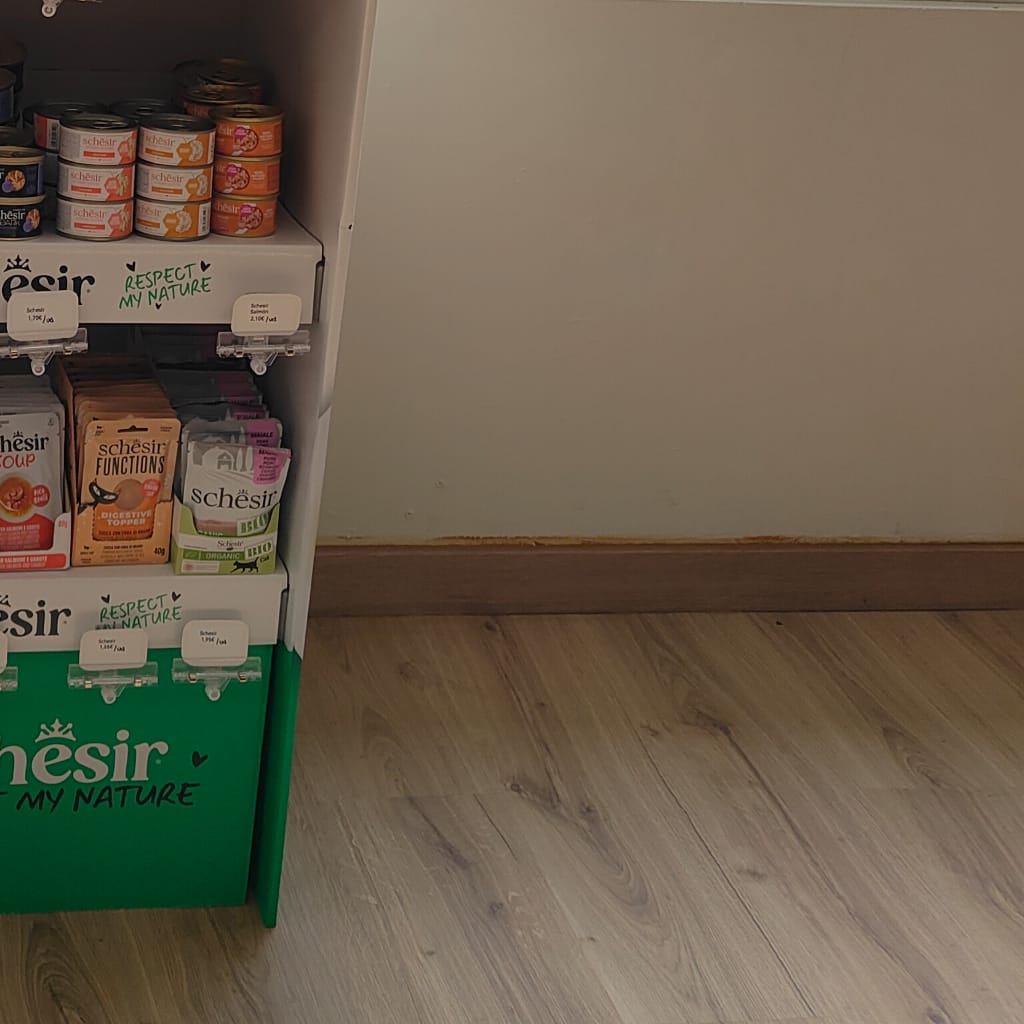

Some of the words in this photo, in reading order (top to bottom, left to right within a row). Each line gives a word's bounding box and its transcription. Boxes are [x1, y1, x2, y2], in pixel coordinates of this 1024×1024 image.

[125, 264, 196, 292] RESPECT
[118, 293, 142, 310] MY
[148, 276, 212, 305] NATURE
[96, 455, 165, 476] FUNCTIONS
[101, 510, 153, 520] DIGESTIVE
[107, 518, 146, 526] TOPPER
[99, 594, 168, 622] RESPECT
[16, 787, 64, 814] MY
[73, 782, 201, 813] NATURE
